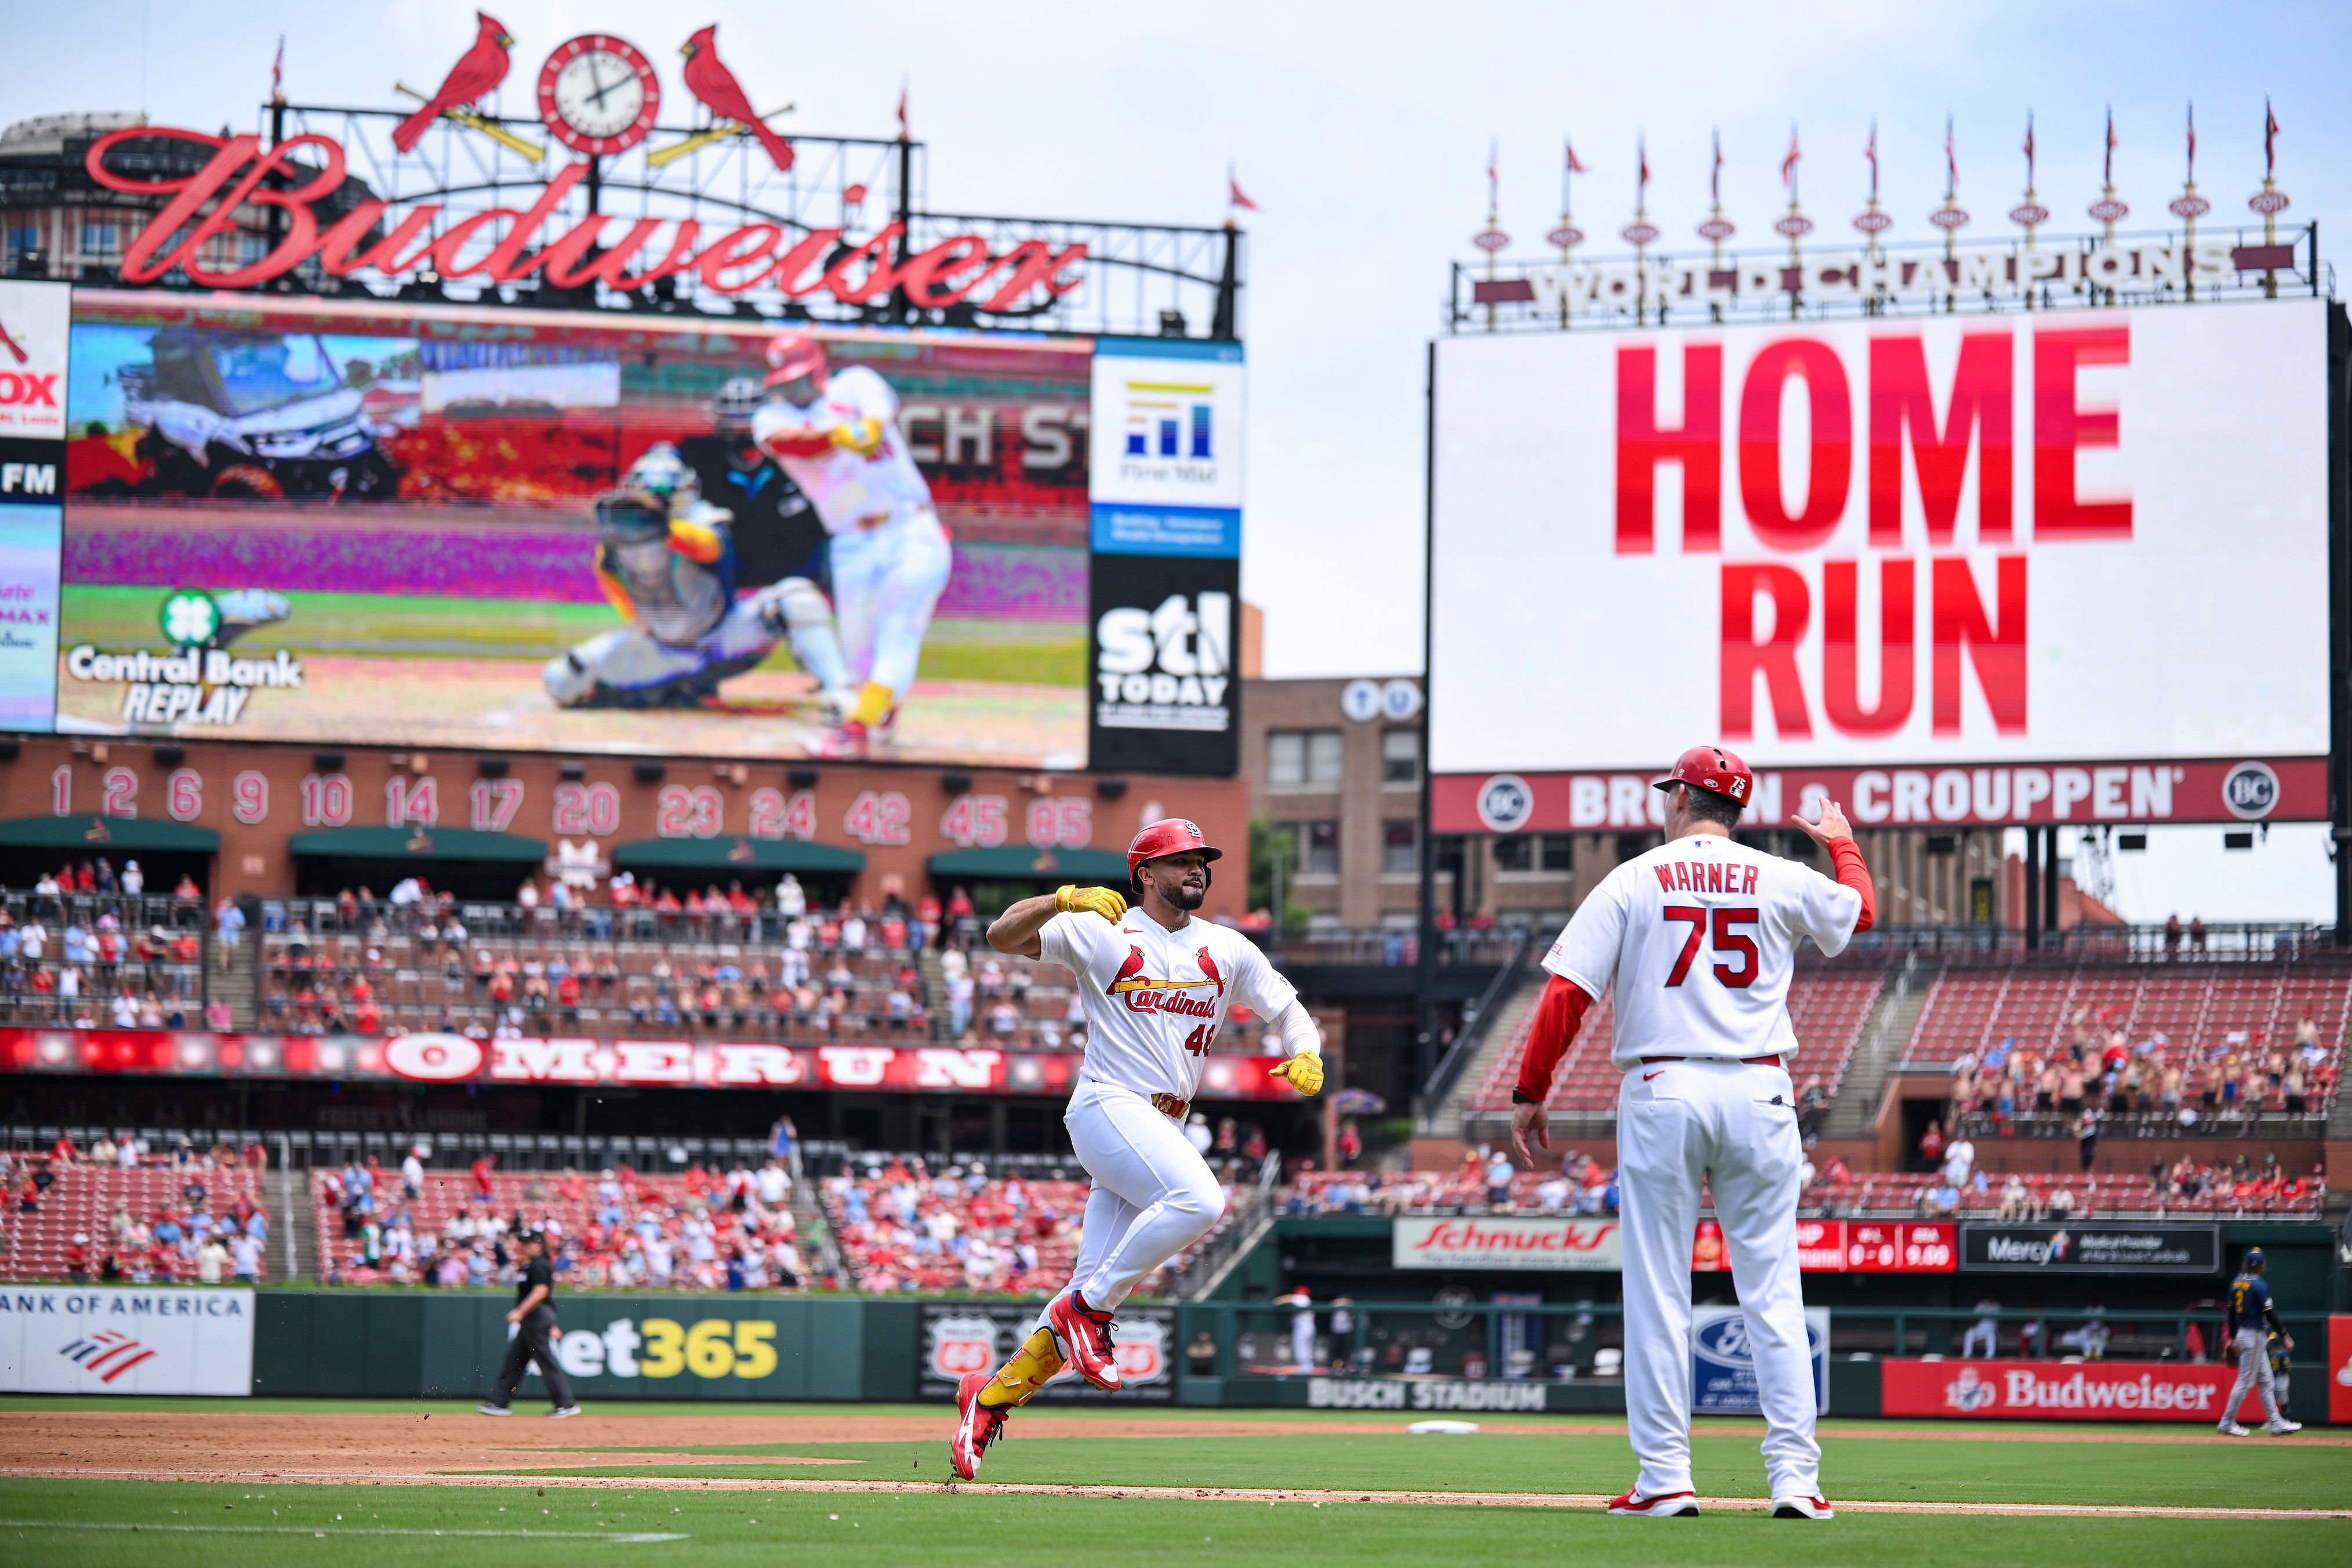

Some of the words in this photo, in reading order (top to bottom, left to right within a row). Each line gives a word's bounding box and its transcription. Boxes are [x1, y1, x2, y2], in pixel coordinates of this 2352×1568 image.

[86, 126, 1088, 311] Budweiser
[1527, 261, 1782, 313] WORLD
[1801, 238, 2235, 298] CHAMPIONS
[1614, 324, 2133, 553] HOME
[2, 463, 56, 495] FM
[1097, 591, 1231, 676] stl
[1719, 555, 2028, 741] RUN
[67, 644, 201, 684] Central
[205, 648, 306, 687] Bank
[122, 683, 249, 724] REPLAY
[1098, 673, 1228, 706] TODAY
[1570, 773, 1782, 827] BRN
[1732, 775, 1747, 790] 75
[51, 765, 71, 817] 1
[103, 767, 137, 820] 2
[167, 768, 202, 821] 6
[234, 770, 268, 824] 9
[302, 772, 352, 827] 10
[385, 775, 438, 829] 14
[470, 778, 525, 832] 17
[553, 781, 620, 836] 20
[657, 784, 724, 839] 23
[749, 787, 815, 841] 24
[844, 790, 911, 845] 42
[941, 794, 1008, 848] 45
[1026, 796, 1093, 850] 85
[1653, 862, 1759, 895] WARNER
[1664, 905, 1759, 989] 75
[1125, 976, 1216, 1019] Cardinals
[1413, 1220, 1618, 1251] Schnucks
[1988, 1236, 2053, 1266] Mercy
[0, 1294, 56, 1314] ANK
[66, 1295, 101, 1315] OF
[110, 1295, 243, 1317] AMERICA
[941, 1342, 989, 1373] 66
[1308, 1377, 1404, 1408] BUSCH
[1413, 1381, 1547, 1411] STADIUM
[2004, 1369, 2216, 1410] Budweiser
